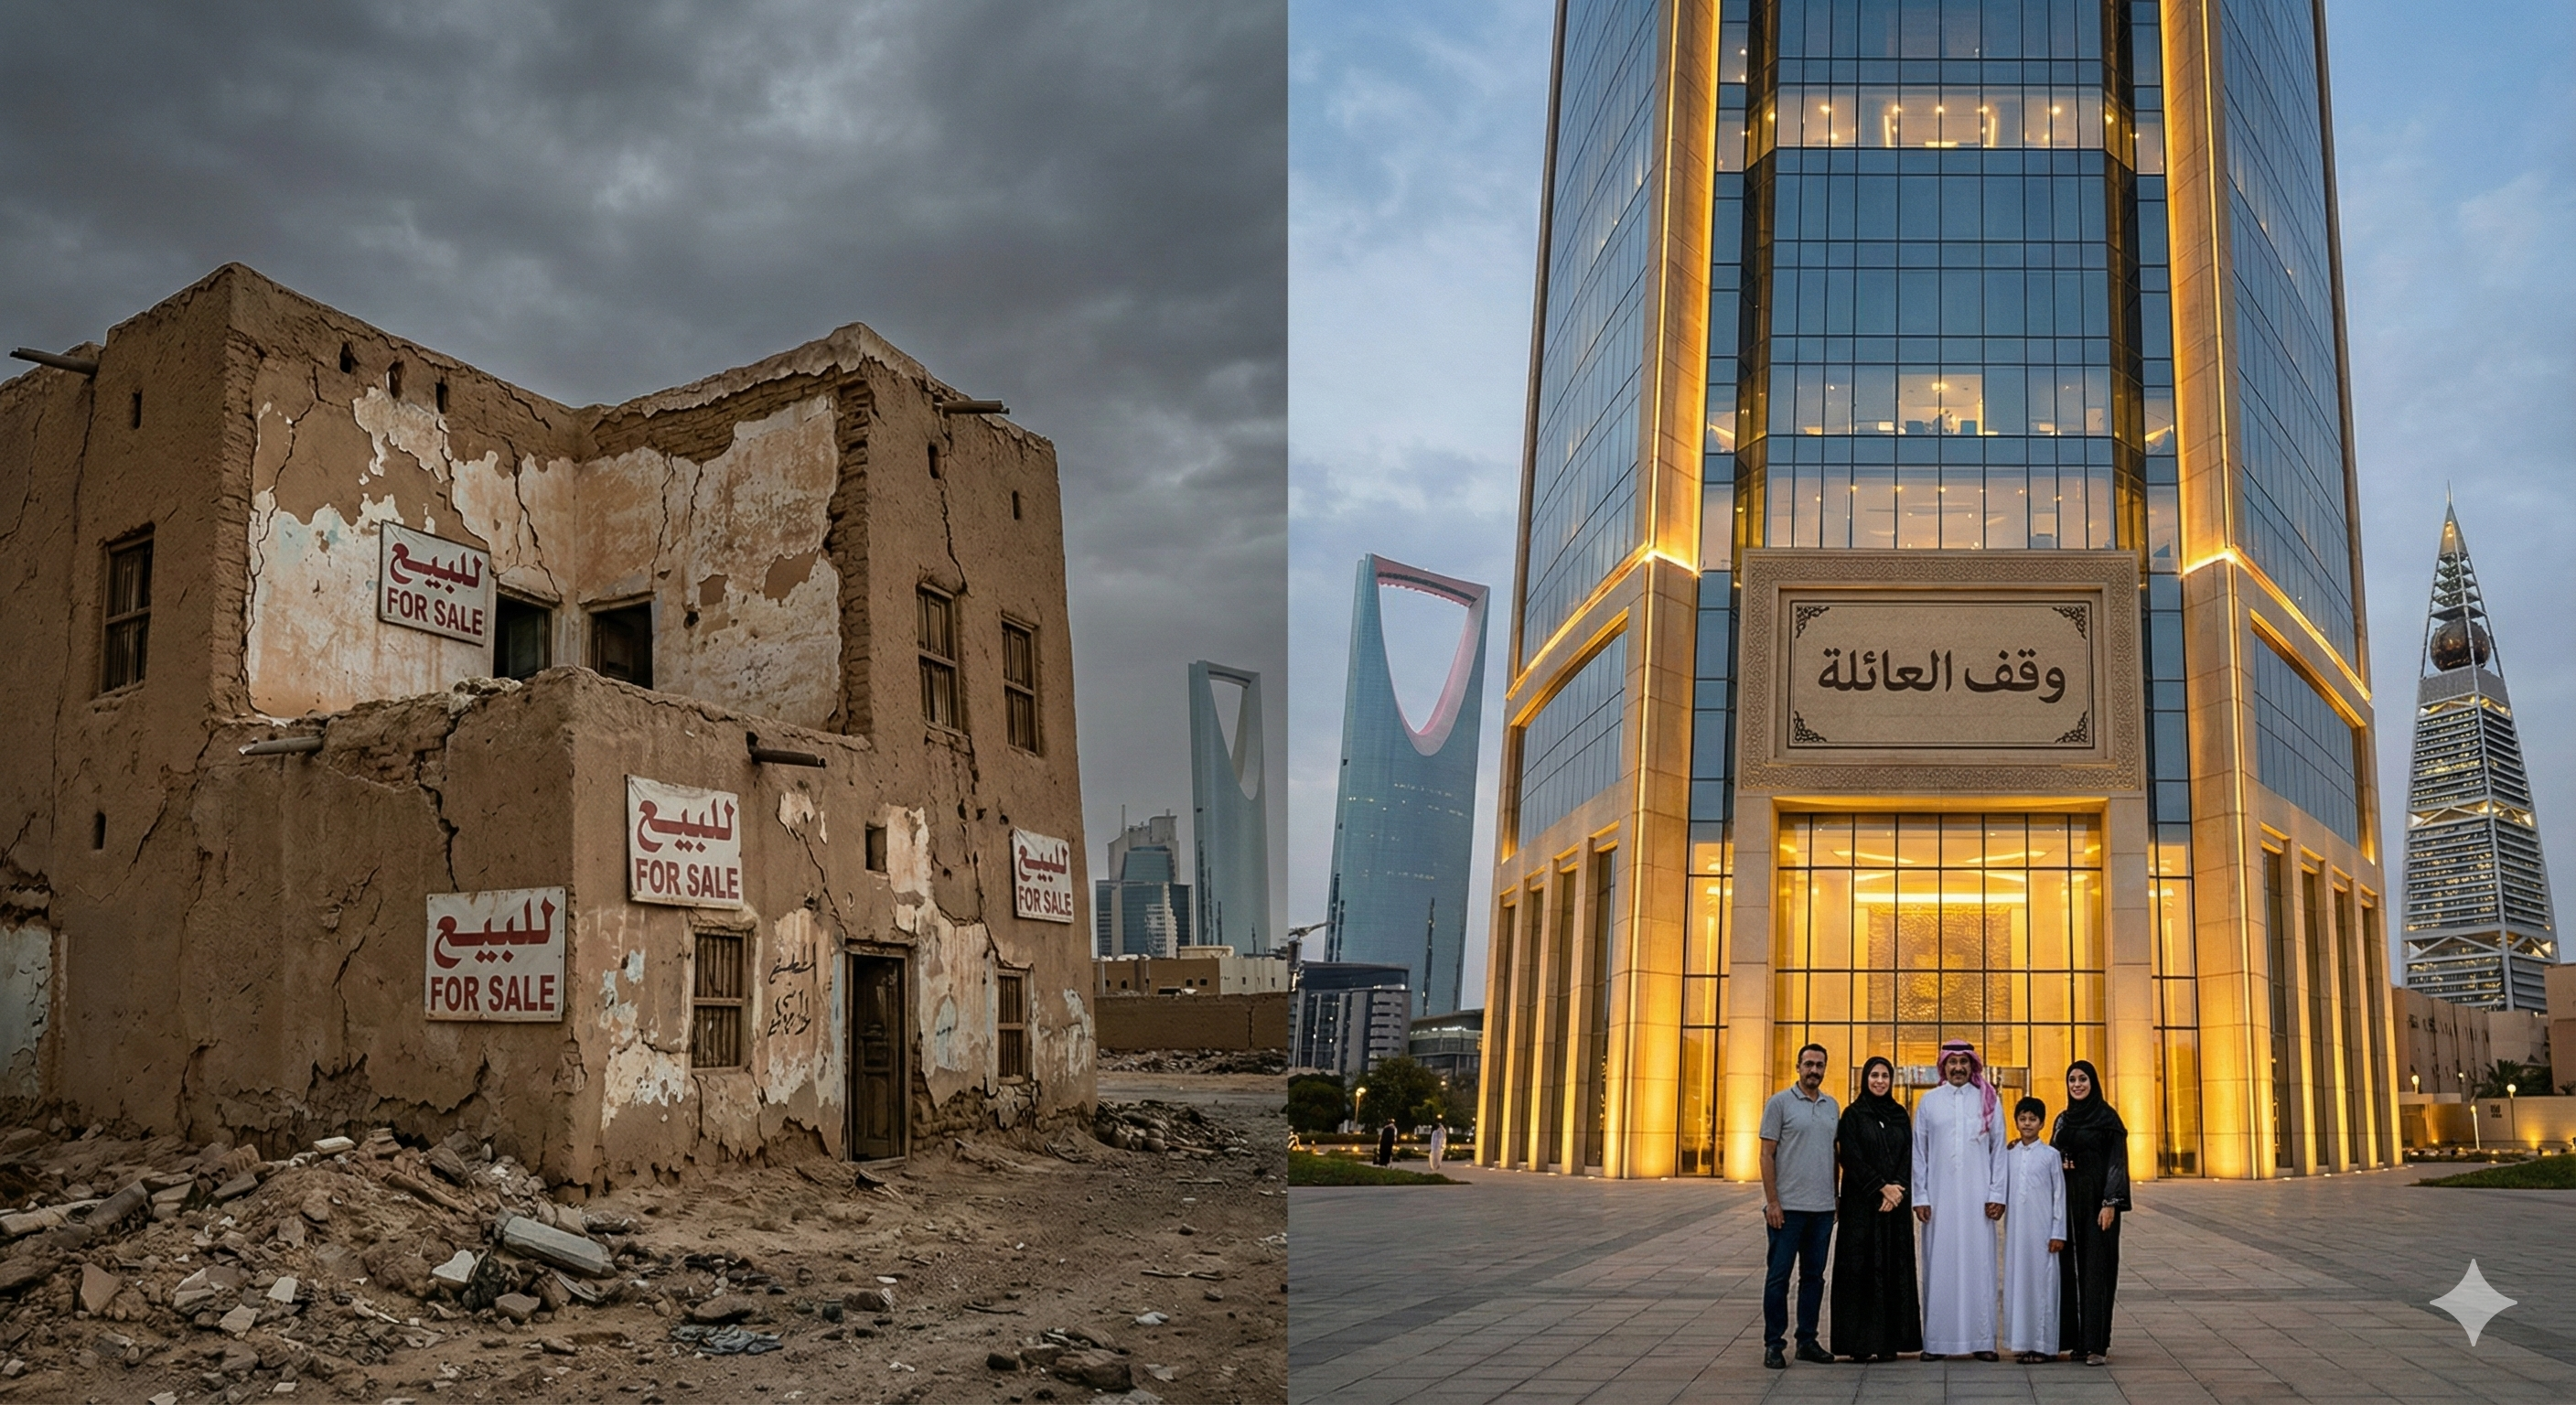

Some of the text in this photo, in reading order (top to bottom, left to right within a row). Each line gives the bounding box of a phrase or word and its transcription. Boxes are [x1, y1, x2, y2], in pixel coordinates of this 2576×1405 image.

[390, 543, 483, 594] للبيع
[388, 586, 483, 636] FOR SALE
[1817, 648, 2066, 703] وقف العائلة
[637, 798, 735, 853] للبيع
[636, 858, 739, 899] FOR SALE
[1019, 845, 1068, 883] للبيع
[1018, 885, 1072, 916] FOR SALE
[434, 896, 556, 970] للبيع
[430, 975, 555, 1012] FOR SALE
